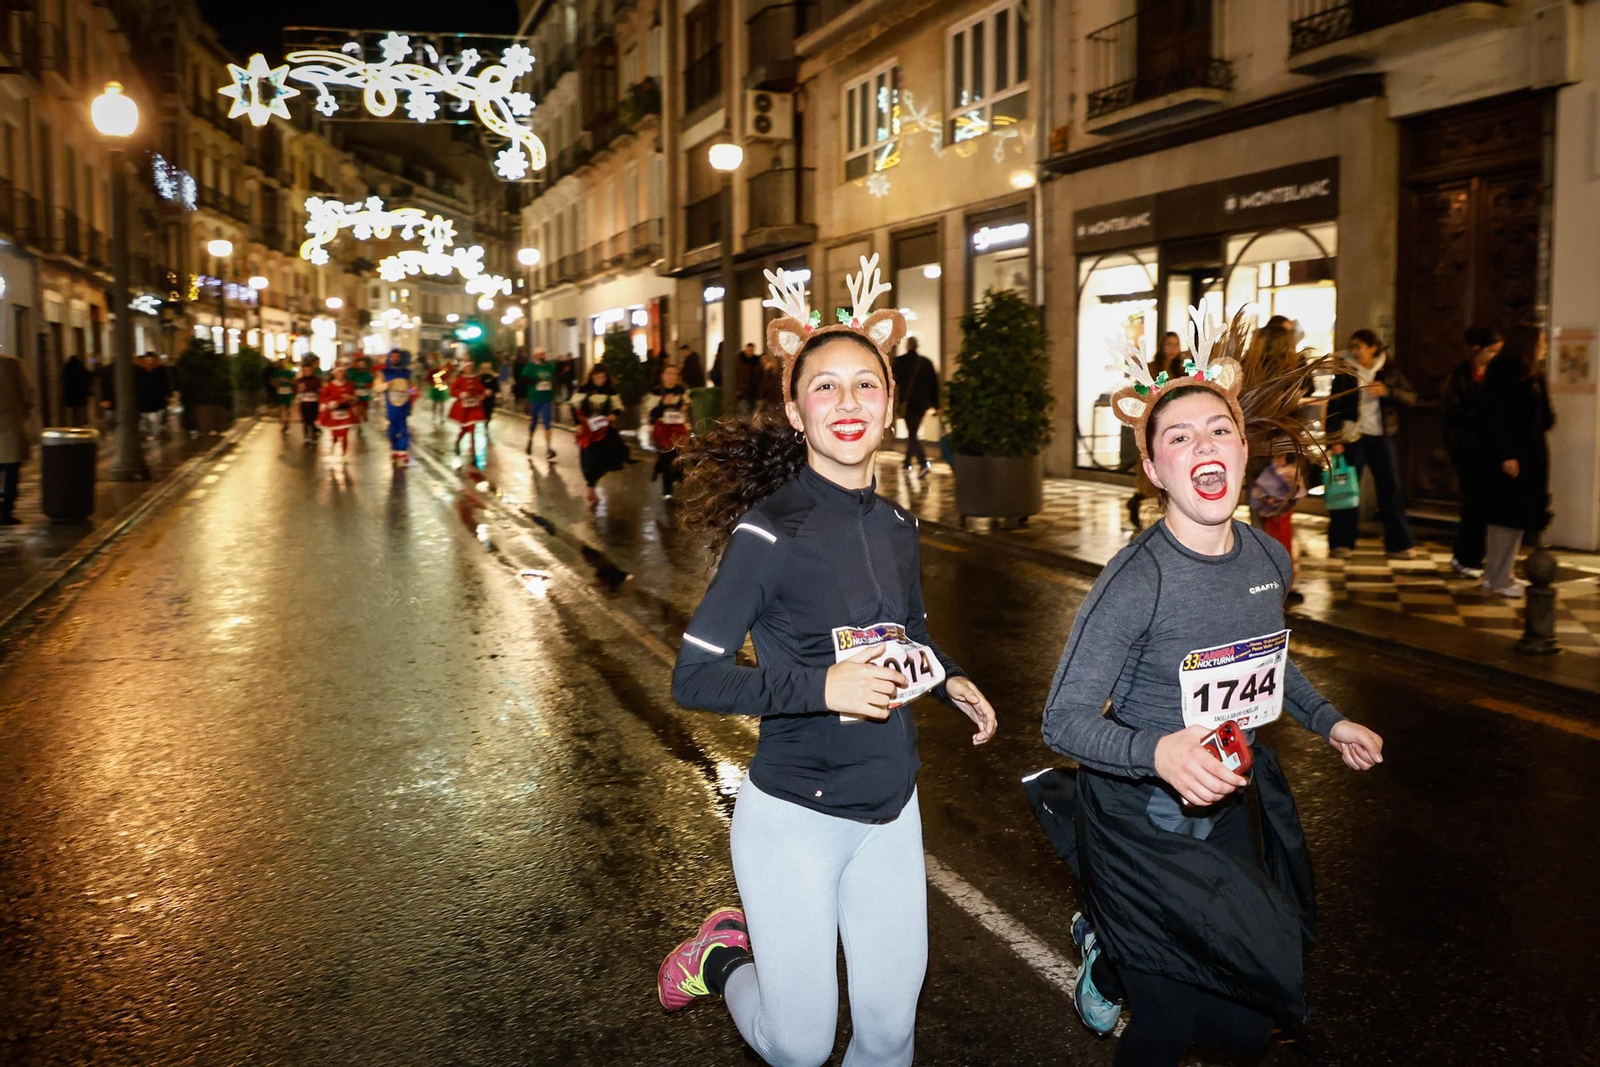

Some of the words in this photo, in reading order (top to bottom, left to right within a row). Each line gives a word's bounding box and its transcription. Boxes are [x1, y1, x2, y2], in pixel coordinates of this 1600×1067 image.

[1240, 179, 1330, 209] MONTBLANC
[1249, 583, 1273, 594] CRAFT
[839, 630, 853, 650] 33
[1183, 653, 1200, 670] 33
[1197, 654, 1235, 669] NOCTURNA
[1199, 646, 1235, 661] CARRERA
[1193, 667, 1276, 712] 1744
